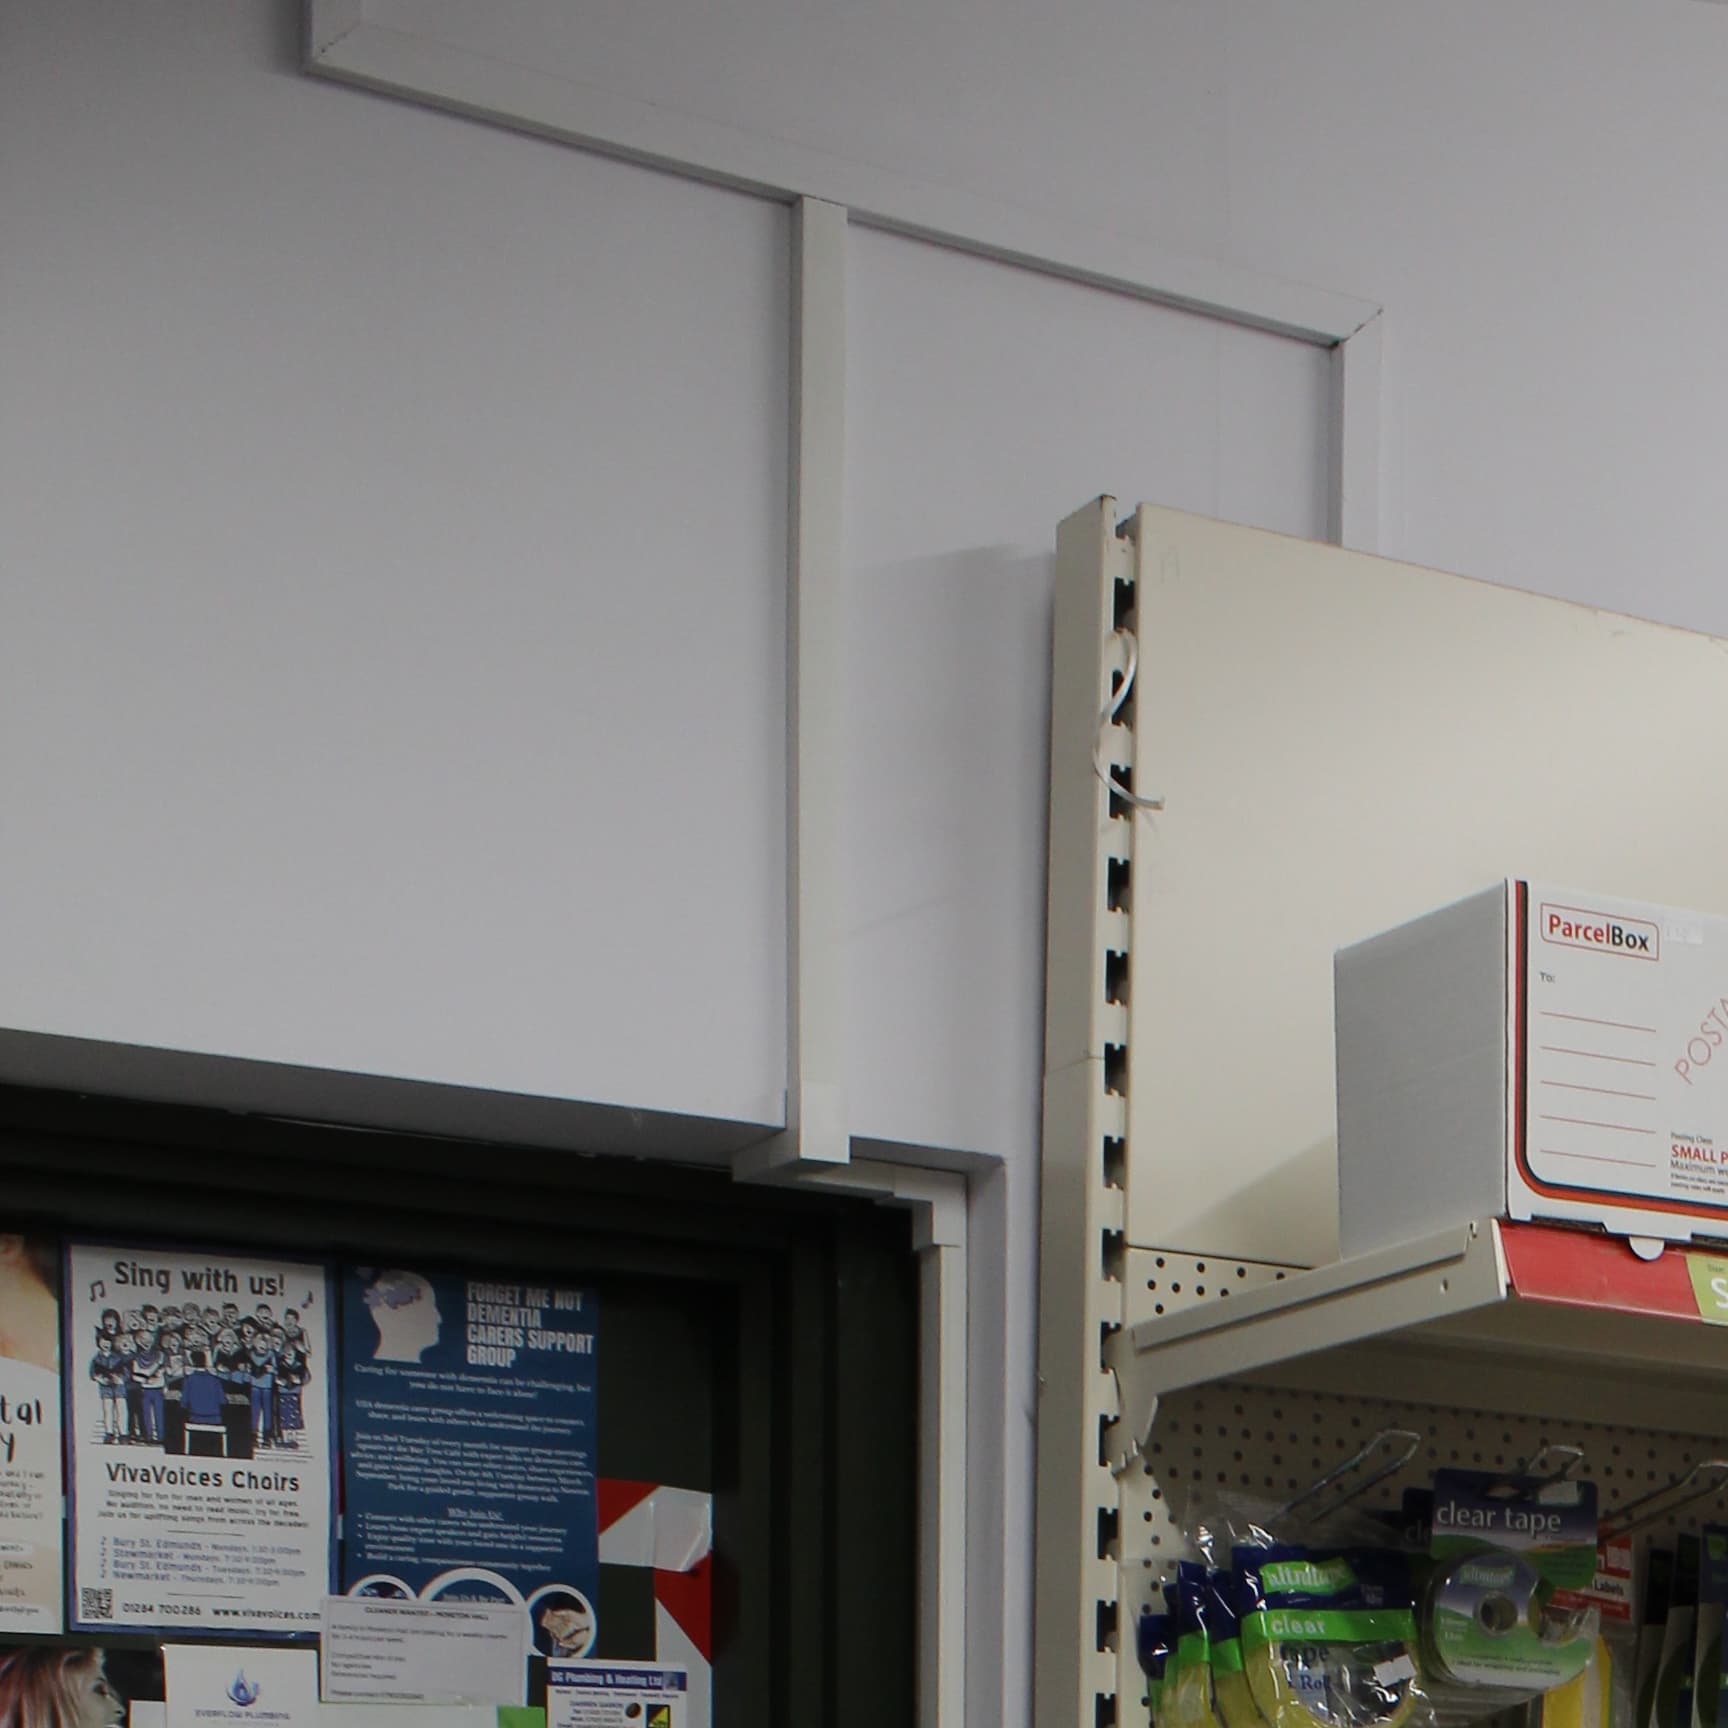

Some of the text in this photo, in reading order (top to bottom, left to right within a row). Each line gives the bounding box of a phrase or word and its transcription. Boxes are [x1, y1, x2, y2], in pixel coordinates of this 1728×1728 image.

[1549, 914, 1650, 952] ParcelBox
[1539, 972, 1555, 983] To:
[1671, 1144, 1718, 1164] SMALL
[114, 1261, 287, 1298] Sing with us!
[467, 1303, 542, 1329] DEMENTIA
[105, 1461, 301, 1493] VivaVoices Choirs
[1437, 1500, 1561, 1536] clear tape
[1271, 1614, 1326, 1635] clear
